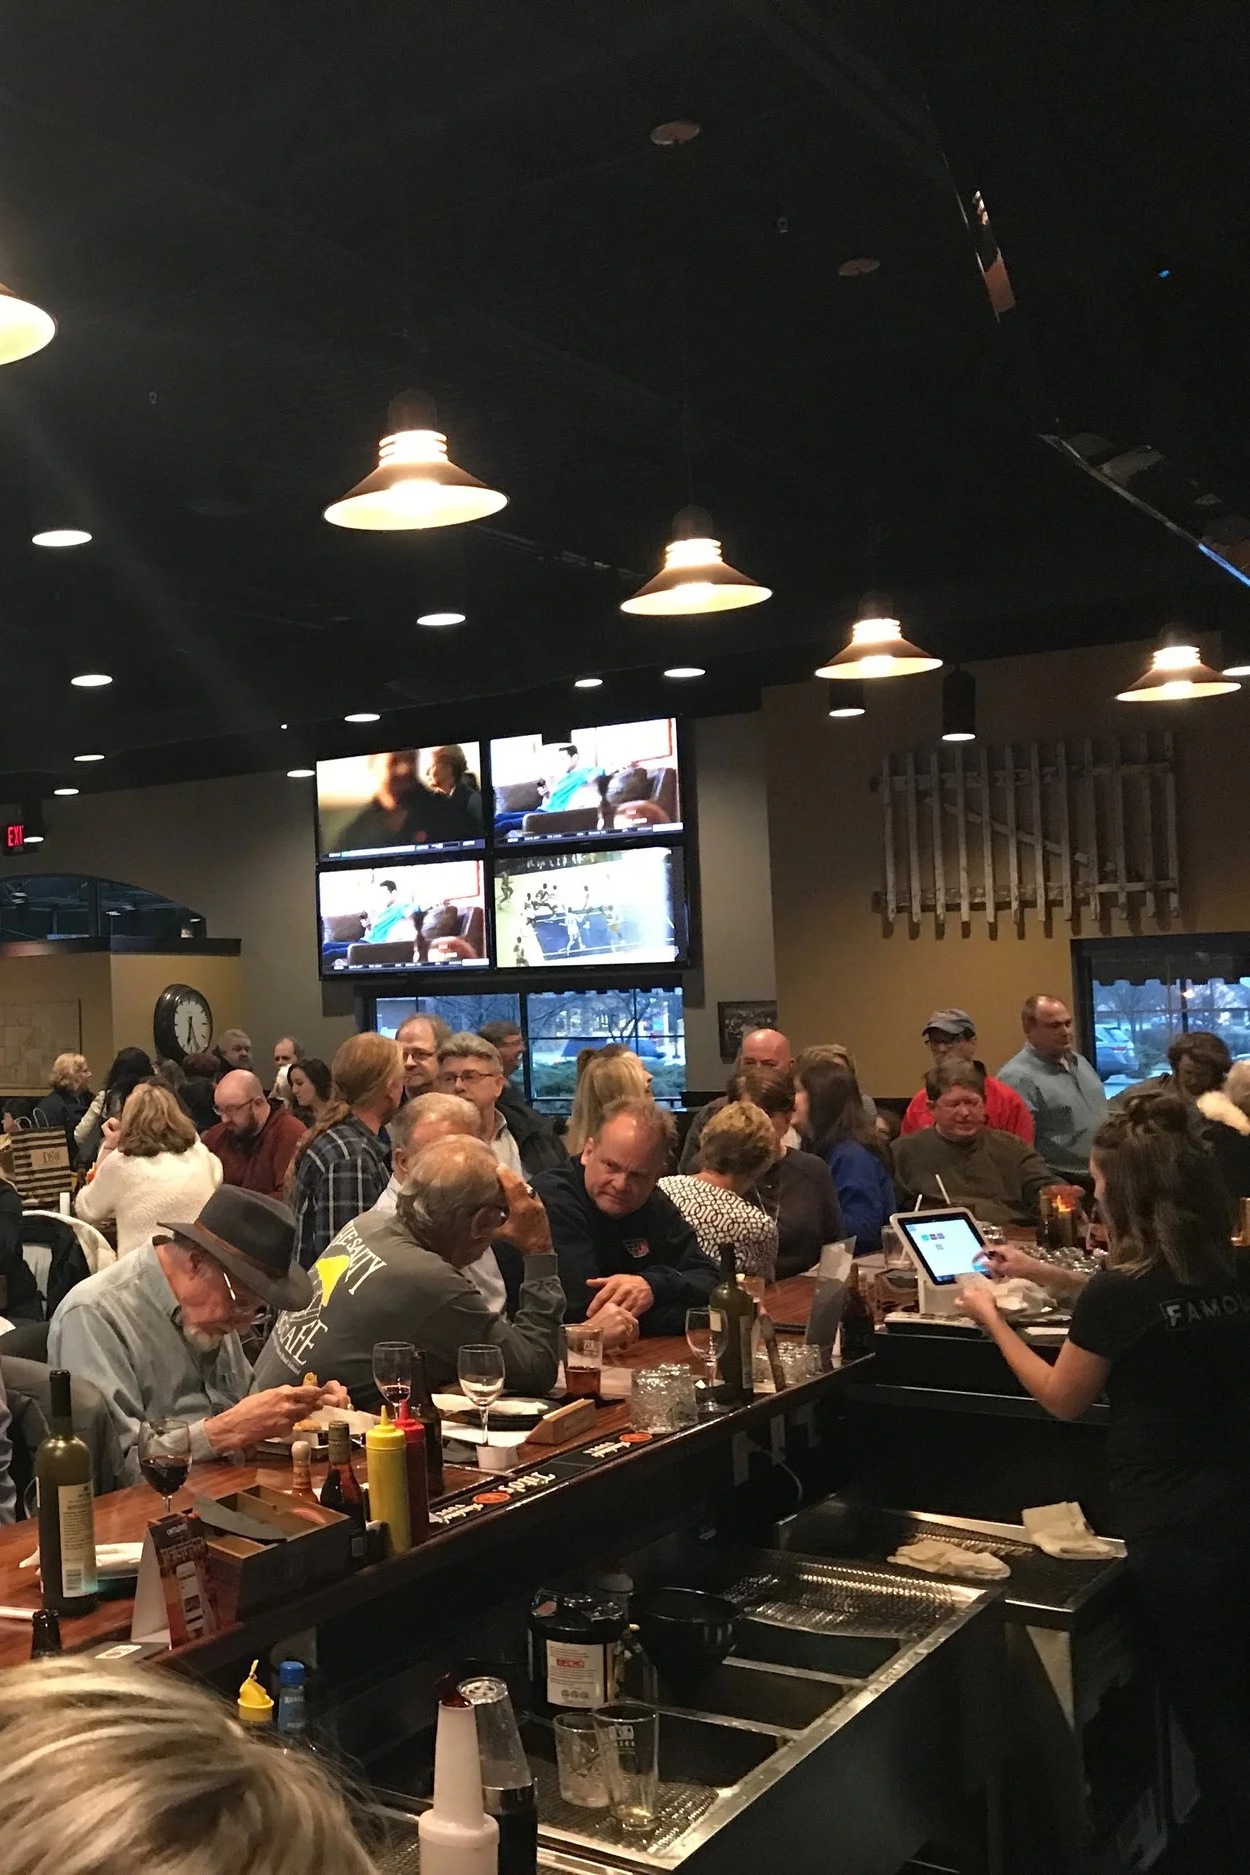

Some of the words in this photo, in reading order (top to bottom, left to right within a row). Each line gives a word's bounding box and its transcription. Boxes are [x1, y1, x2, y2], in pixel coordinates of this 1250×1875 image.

[7, 825, 24, 847] EXI
[42, 1151, 62, 1163] DSW
[344, 1235, 387, 1296] SALTY
